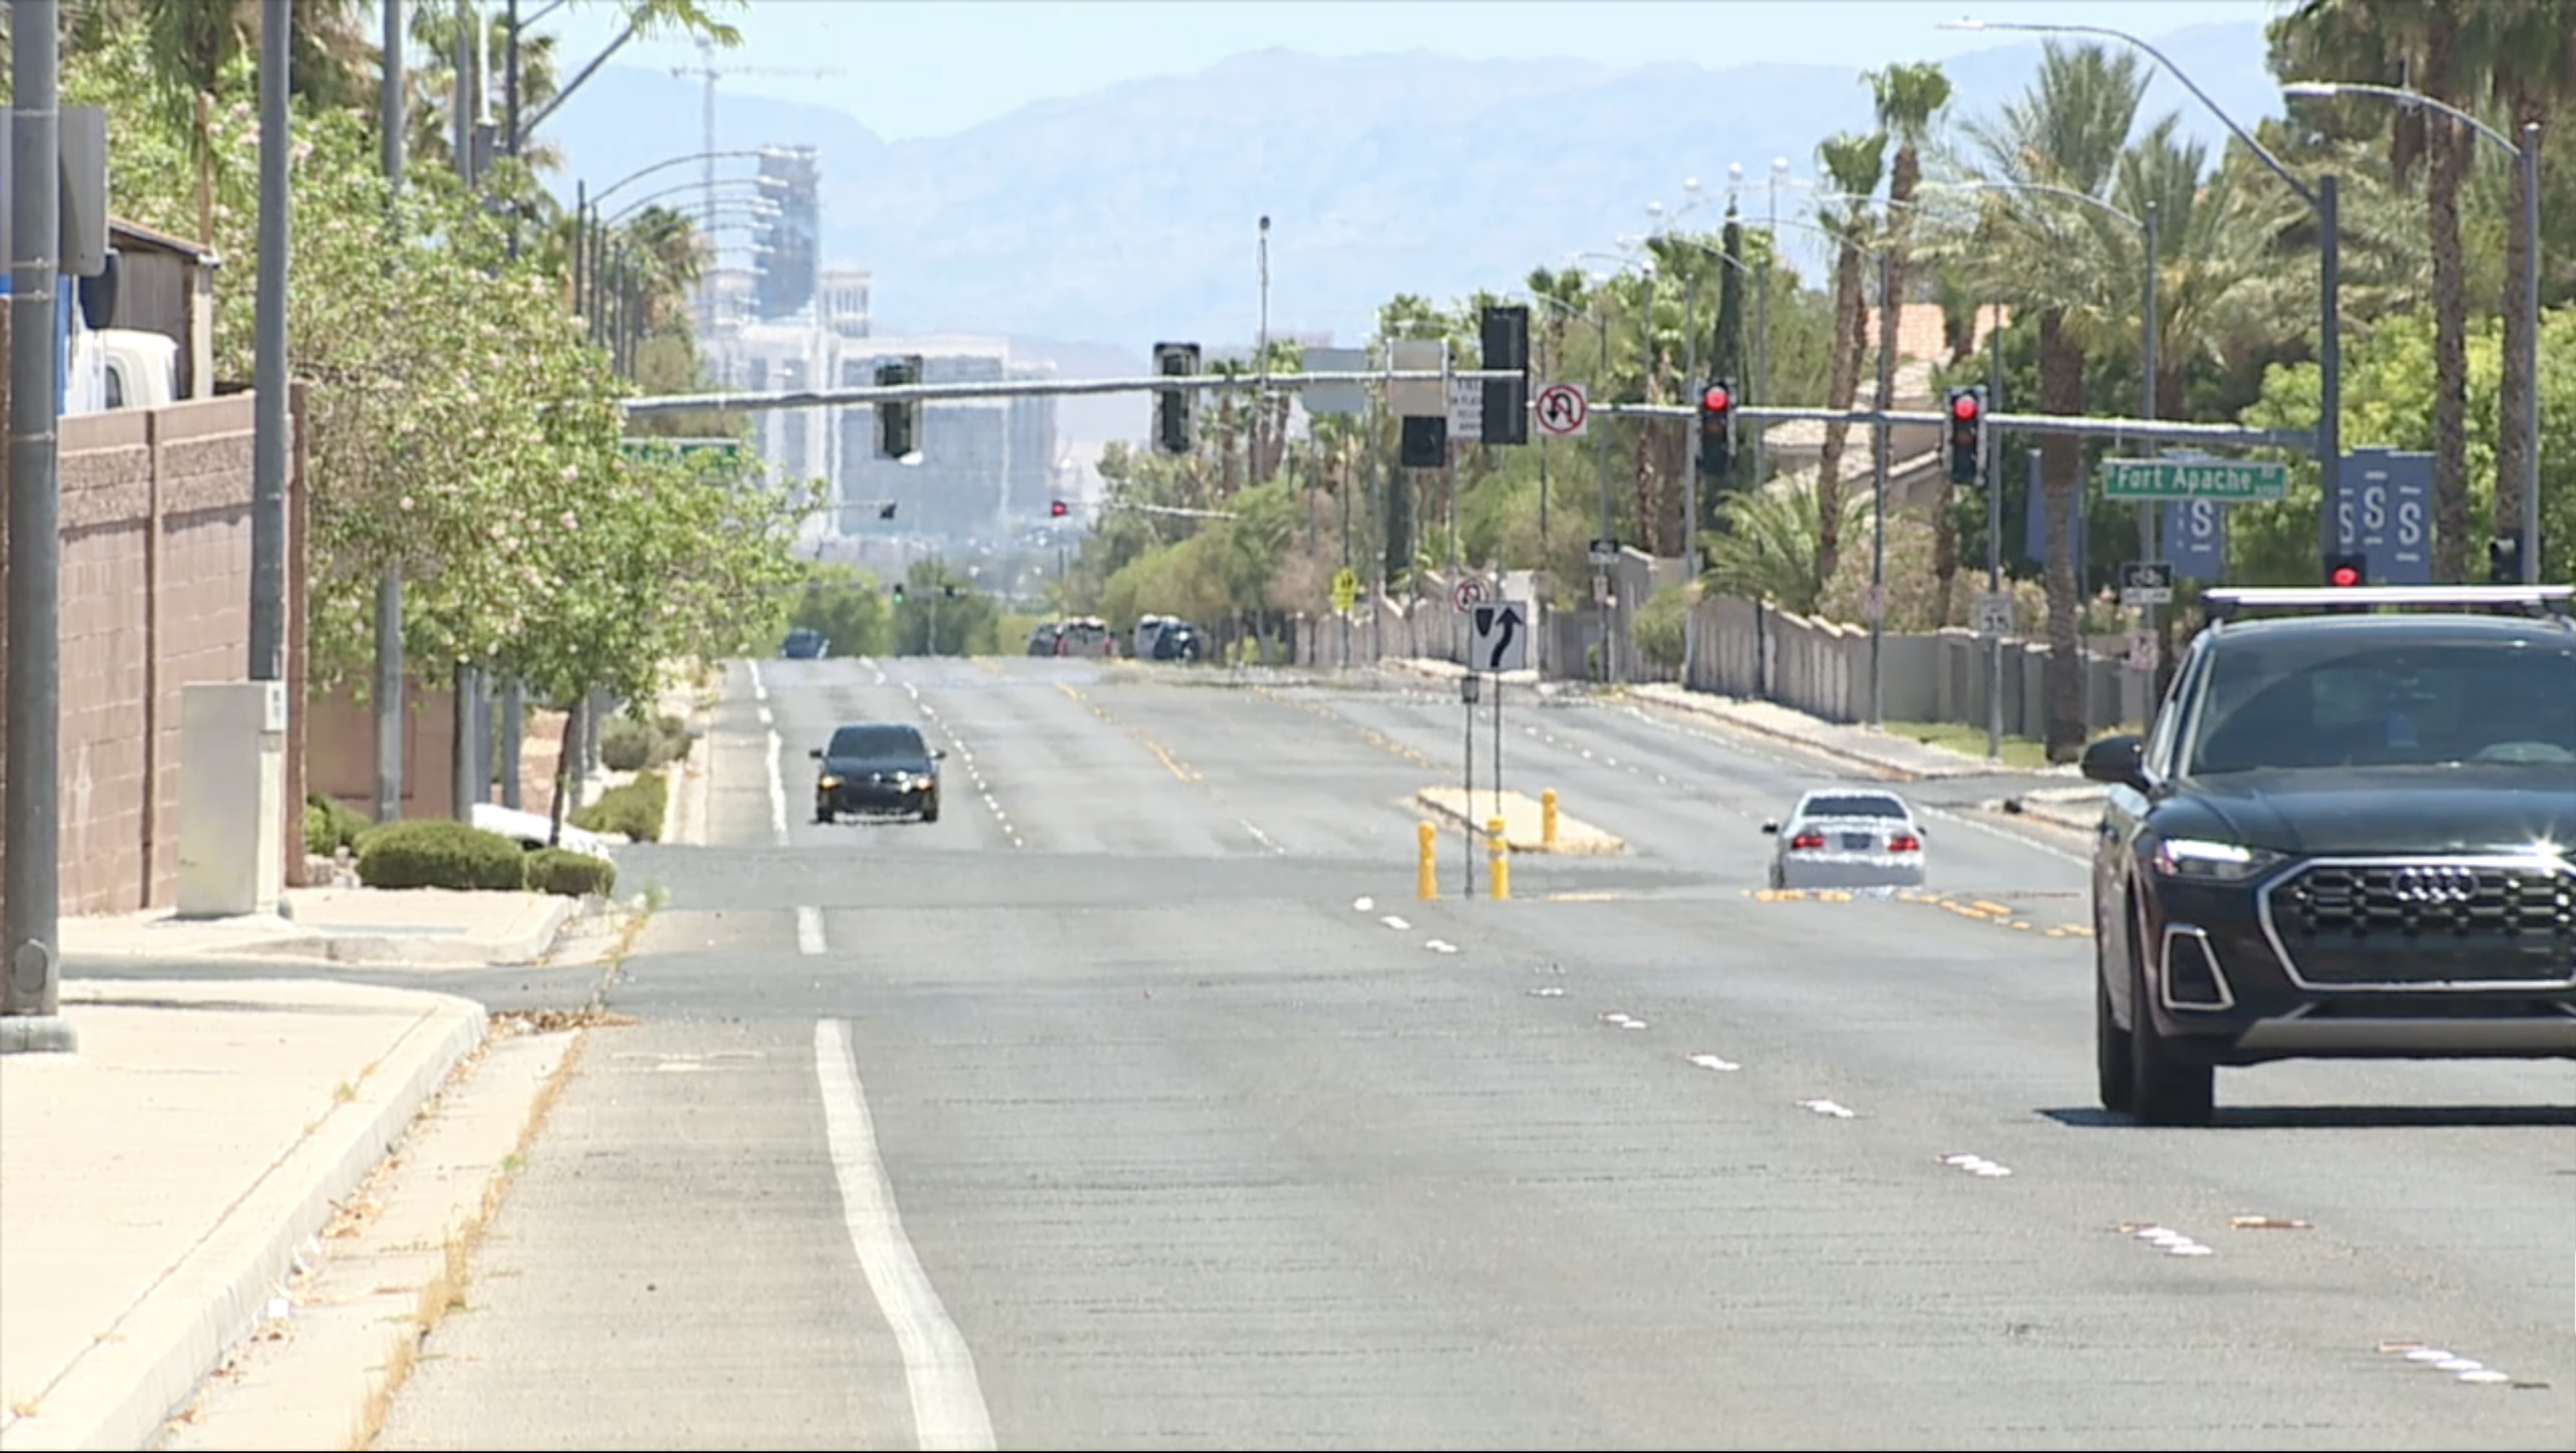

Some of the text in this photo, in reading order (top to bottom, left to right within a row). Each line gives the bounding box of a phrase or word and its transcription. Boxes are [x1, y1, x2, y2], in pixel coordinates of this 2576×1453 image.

[2117, 466, 2163, 489] Fort
[2173, 466, 2252, 495] Apache
[2364, 486, 2386, 530] S
[2399, 501, 2421, 546] S
